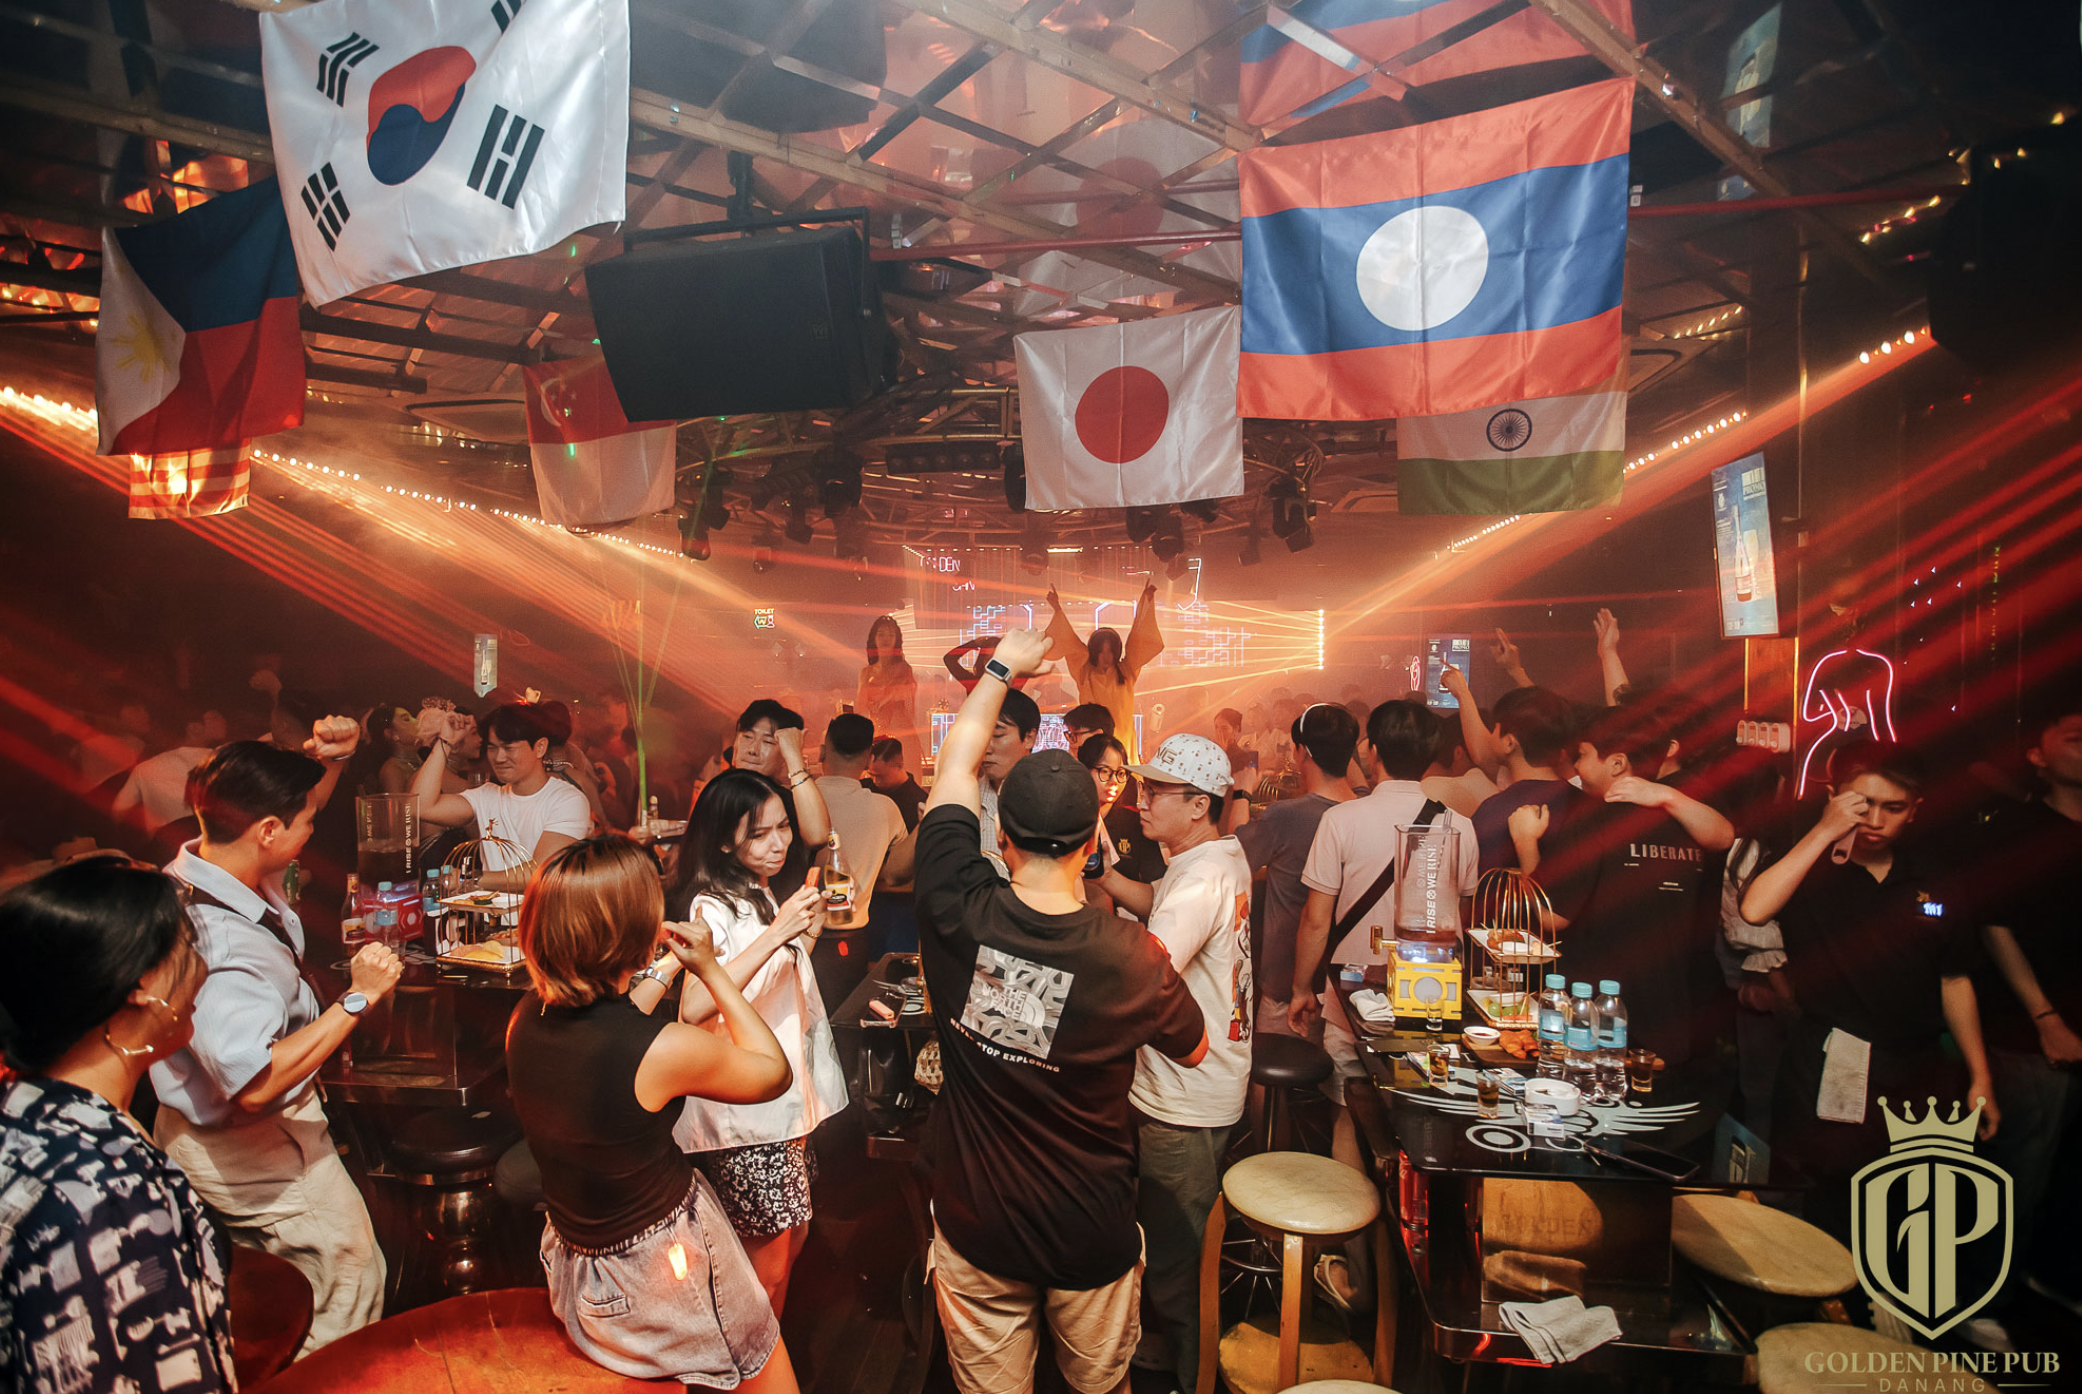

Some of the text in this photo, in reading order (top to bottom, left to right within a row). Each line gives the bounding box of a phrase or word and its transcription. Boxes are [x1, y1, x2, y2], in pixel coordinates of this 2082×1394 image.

[1630, 843, 1702, 862] LIBERATE
[1426, 872, 1438, 889] WE
[1426, 900, 1437, 929] RISE
[981, 984, 1024, 1011] NORTH
[1003, 987, 1027, 1000] THE
[990, 1001, 1021, 1020] FACE
[1002, 1052, 1060, 1073] EXPLORING
